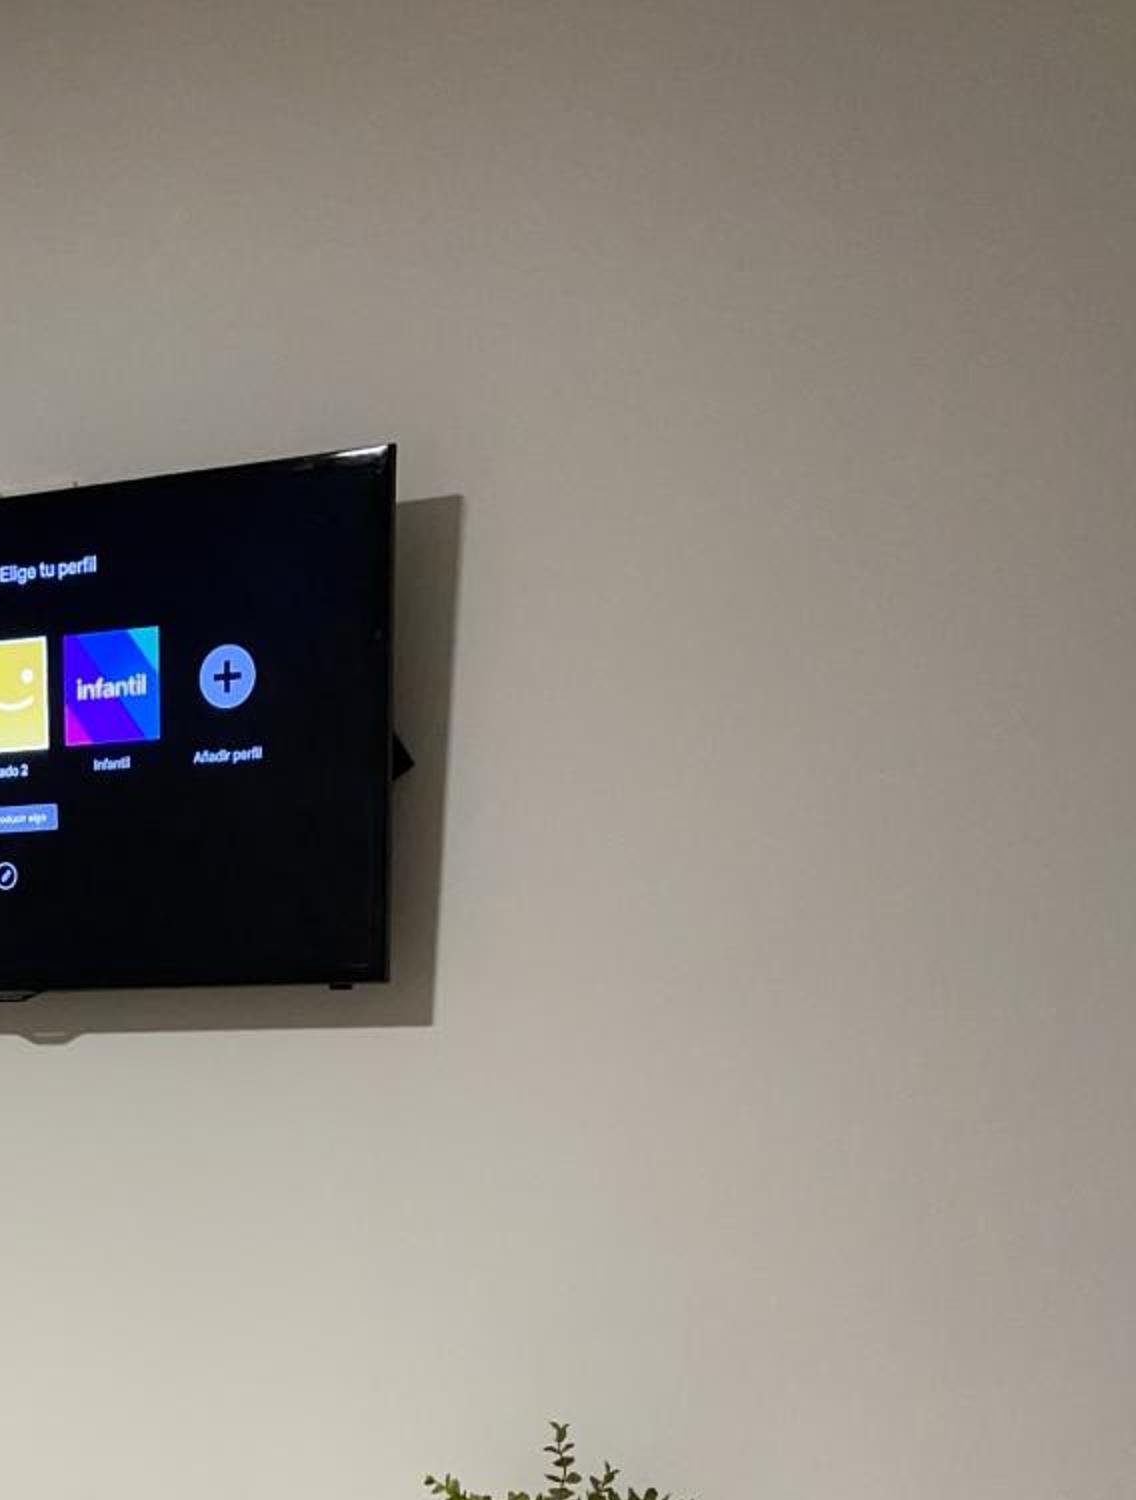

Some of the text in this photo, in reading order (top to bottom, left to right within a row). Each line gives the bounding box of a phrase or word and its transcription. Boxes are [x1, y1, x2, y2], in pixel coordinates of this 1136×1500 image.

[0, 565, 36, 584] Elige
[38, 562, 55, 577] tu
[58, 555, 97, 580] perfil
[76, 673, 148, 700] infantil
[93, 755, 131, 771] Infantil
[193, 746, 263, 764] Añadir perfil
[20, 763, 29, 777] 2
